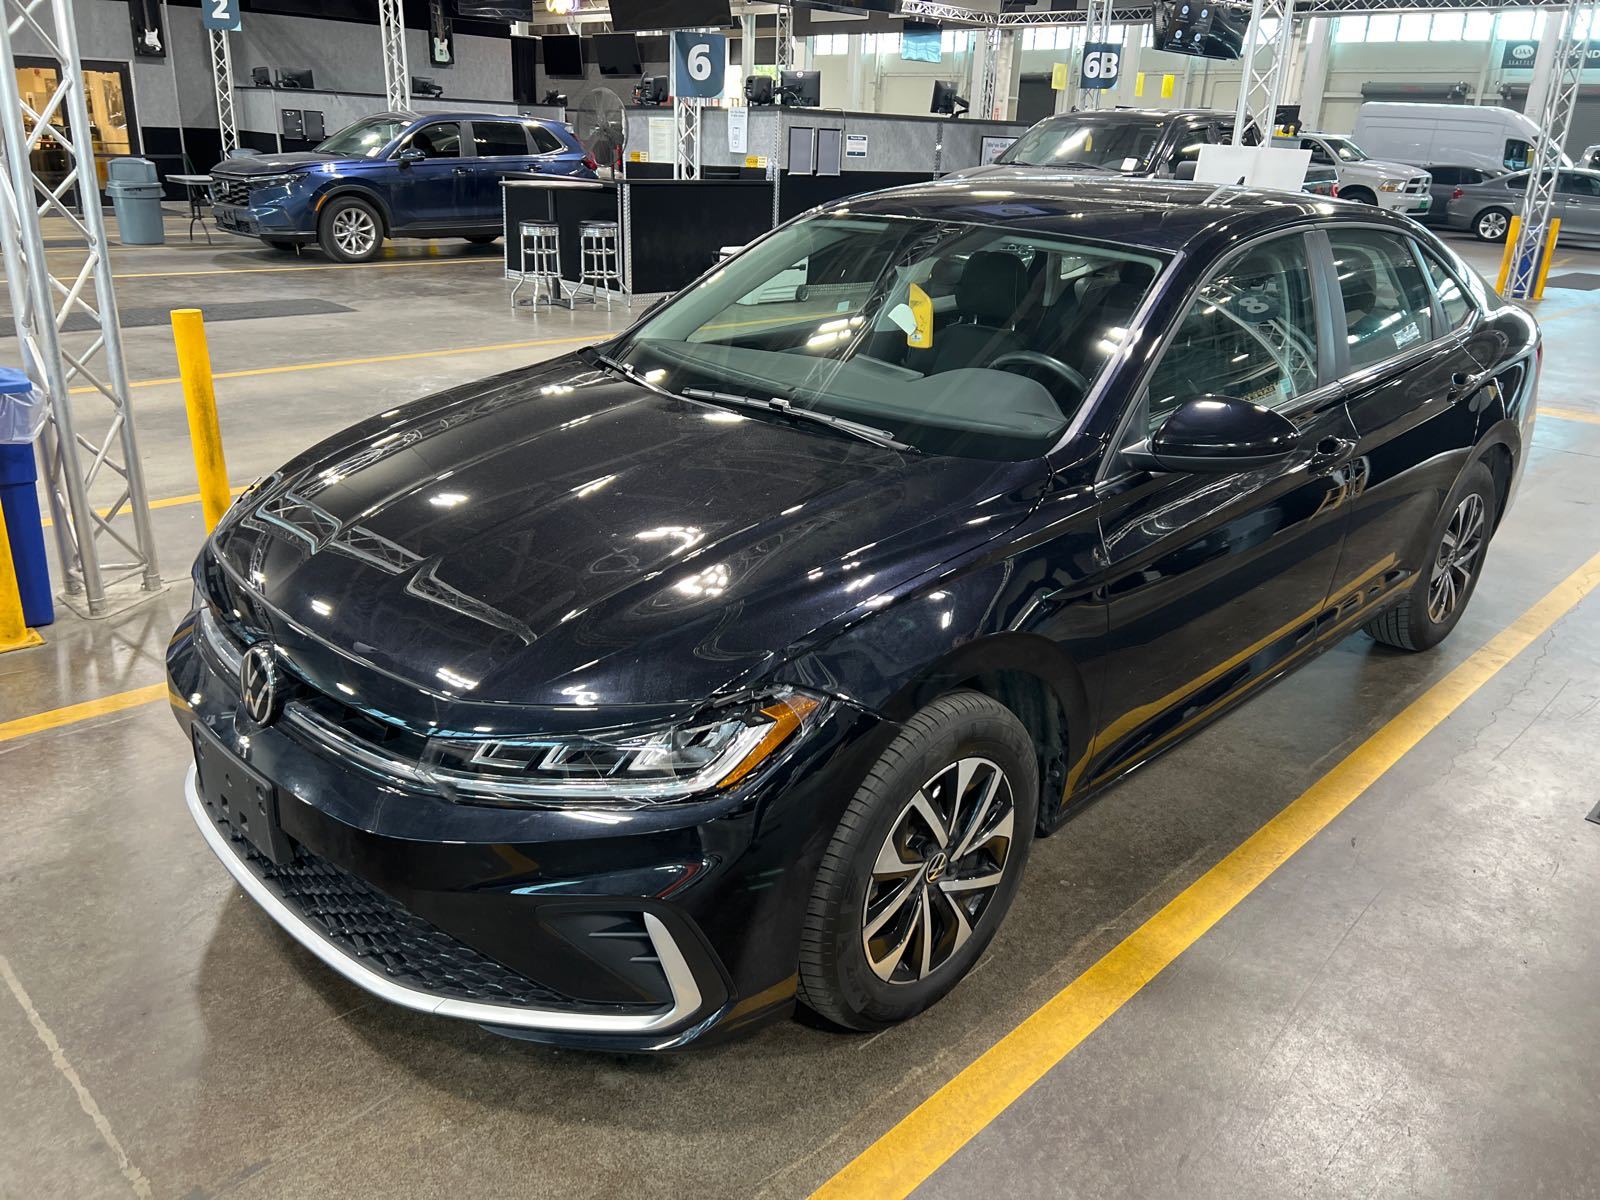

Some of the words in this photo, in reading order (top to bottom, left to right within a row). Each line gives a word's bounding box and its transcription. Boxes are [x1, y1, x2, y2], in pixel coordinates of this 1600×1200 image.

[212, 0, 230, 19] 2
[687, 43, 712, 81] 6
[1083, 51, 1119, 79] 6B
